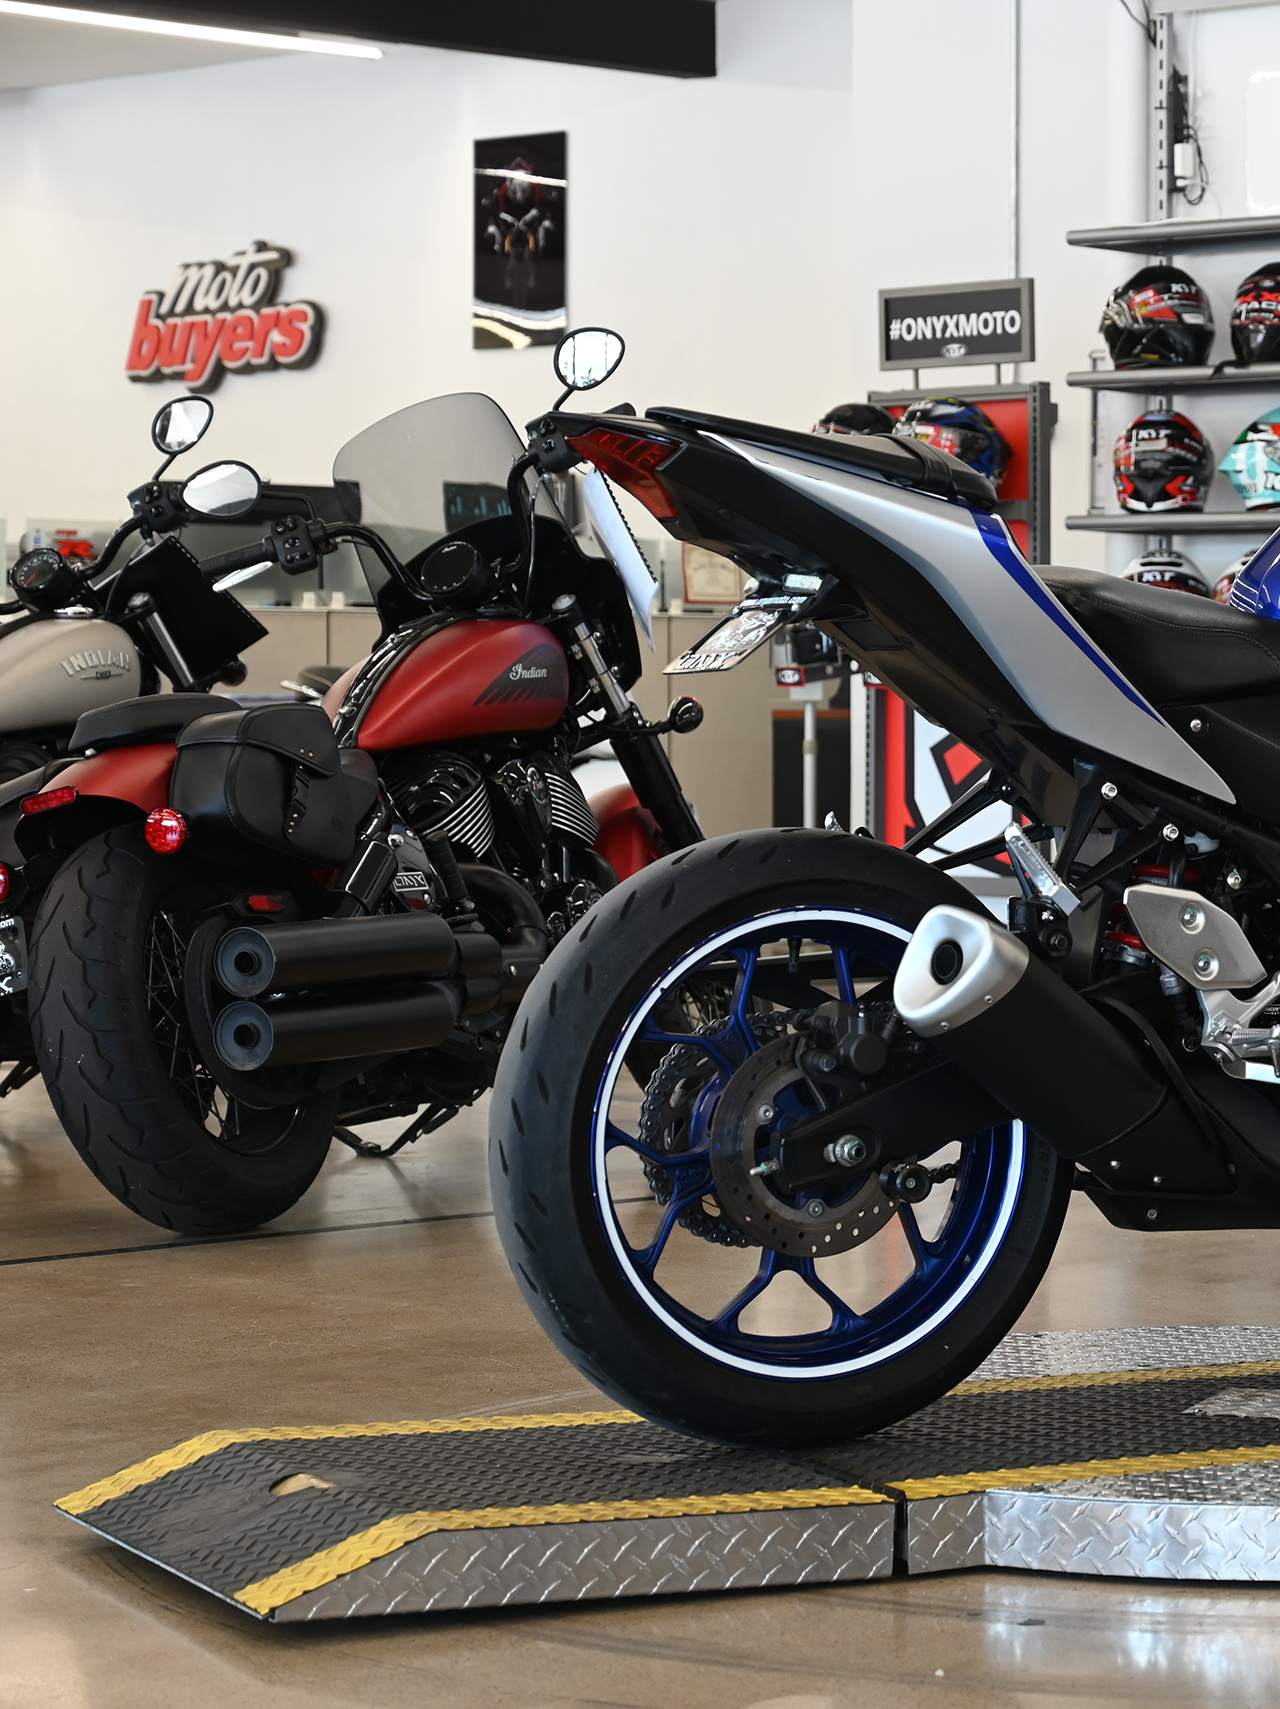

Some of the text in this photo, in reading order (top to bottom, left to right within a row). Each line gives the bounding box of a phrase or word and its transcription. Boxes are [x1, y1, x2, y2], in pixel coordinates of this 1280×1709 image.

[889, 309, 1022, 342] #ONYXMOTO
[125, 296, 312, 385] buyers
[1137, 429, 1172, 440] KYT
[1142, 571, 1176, 583] KYT
[60, 649, 131, 677] INDIAN
[509, 663, 547, 681] Indian
